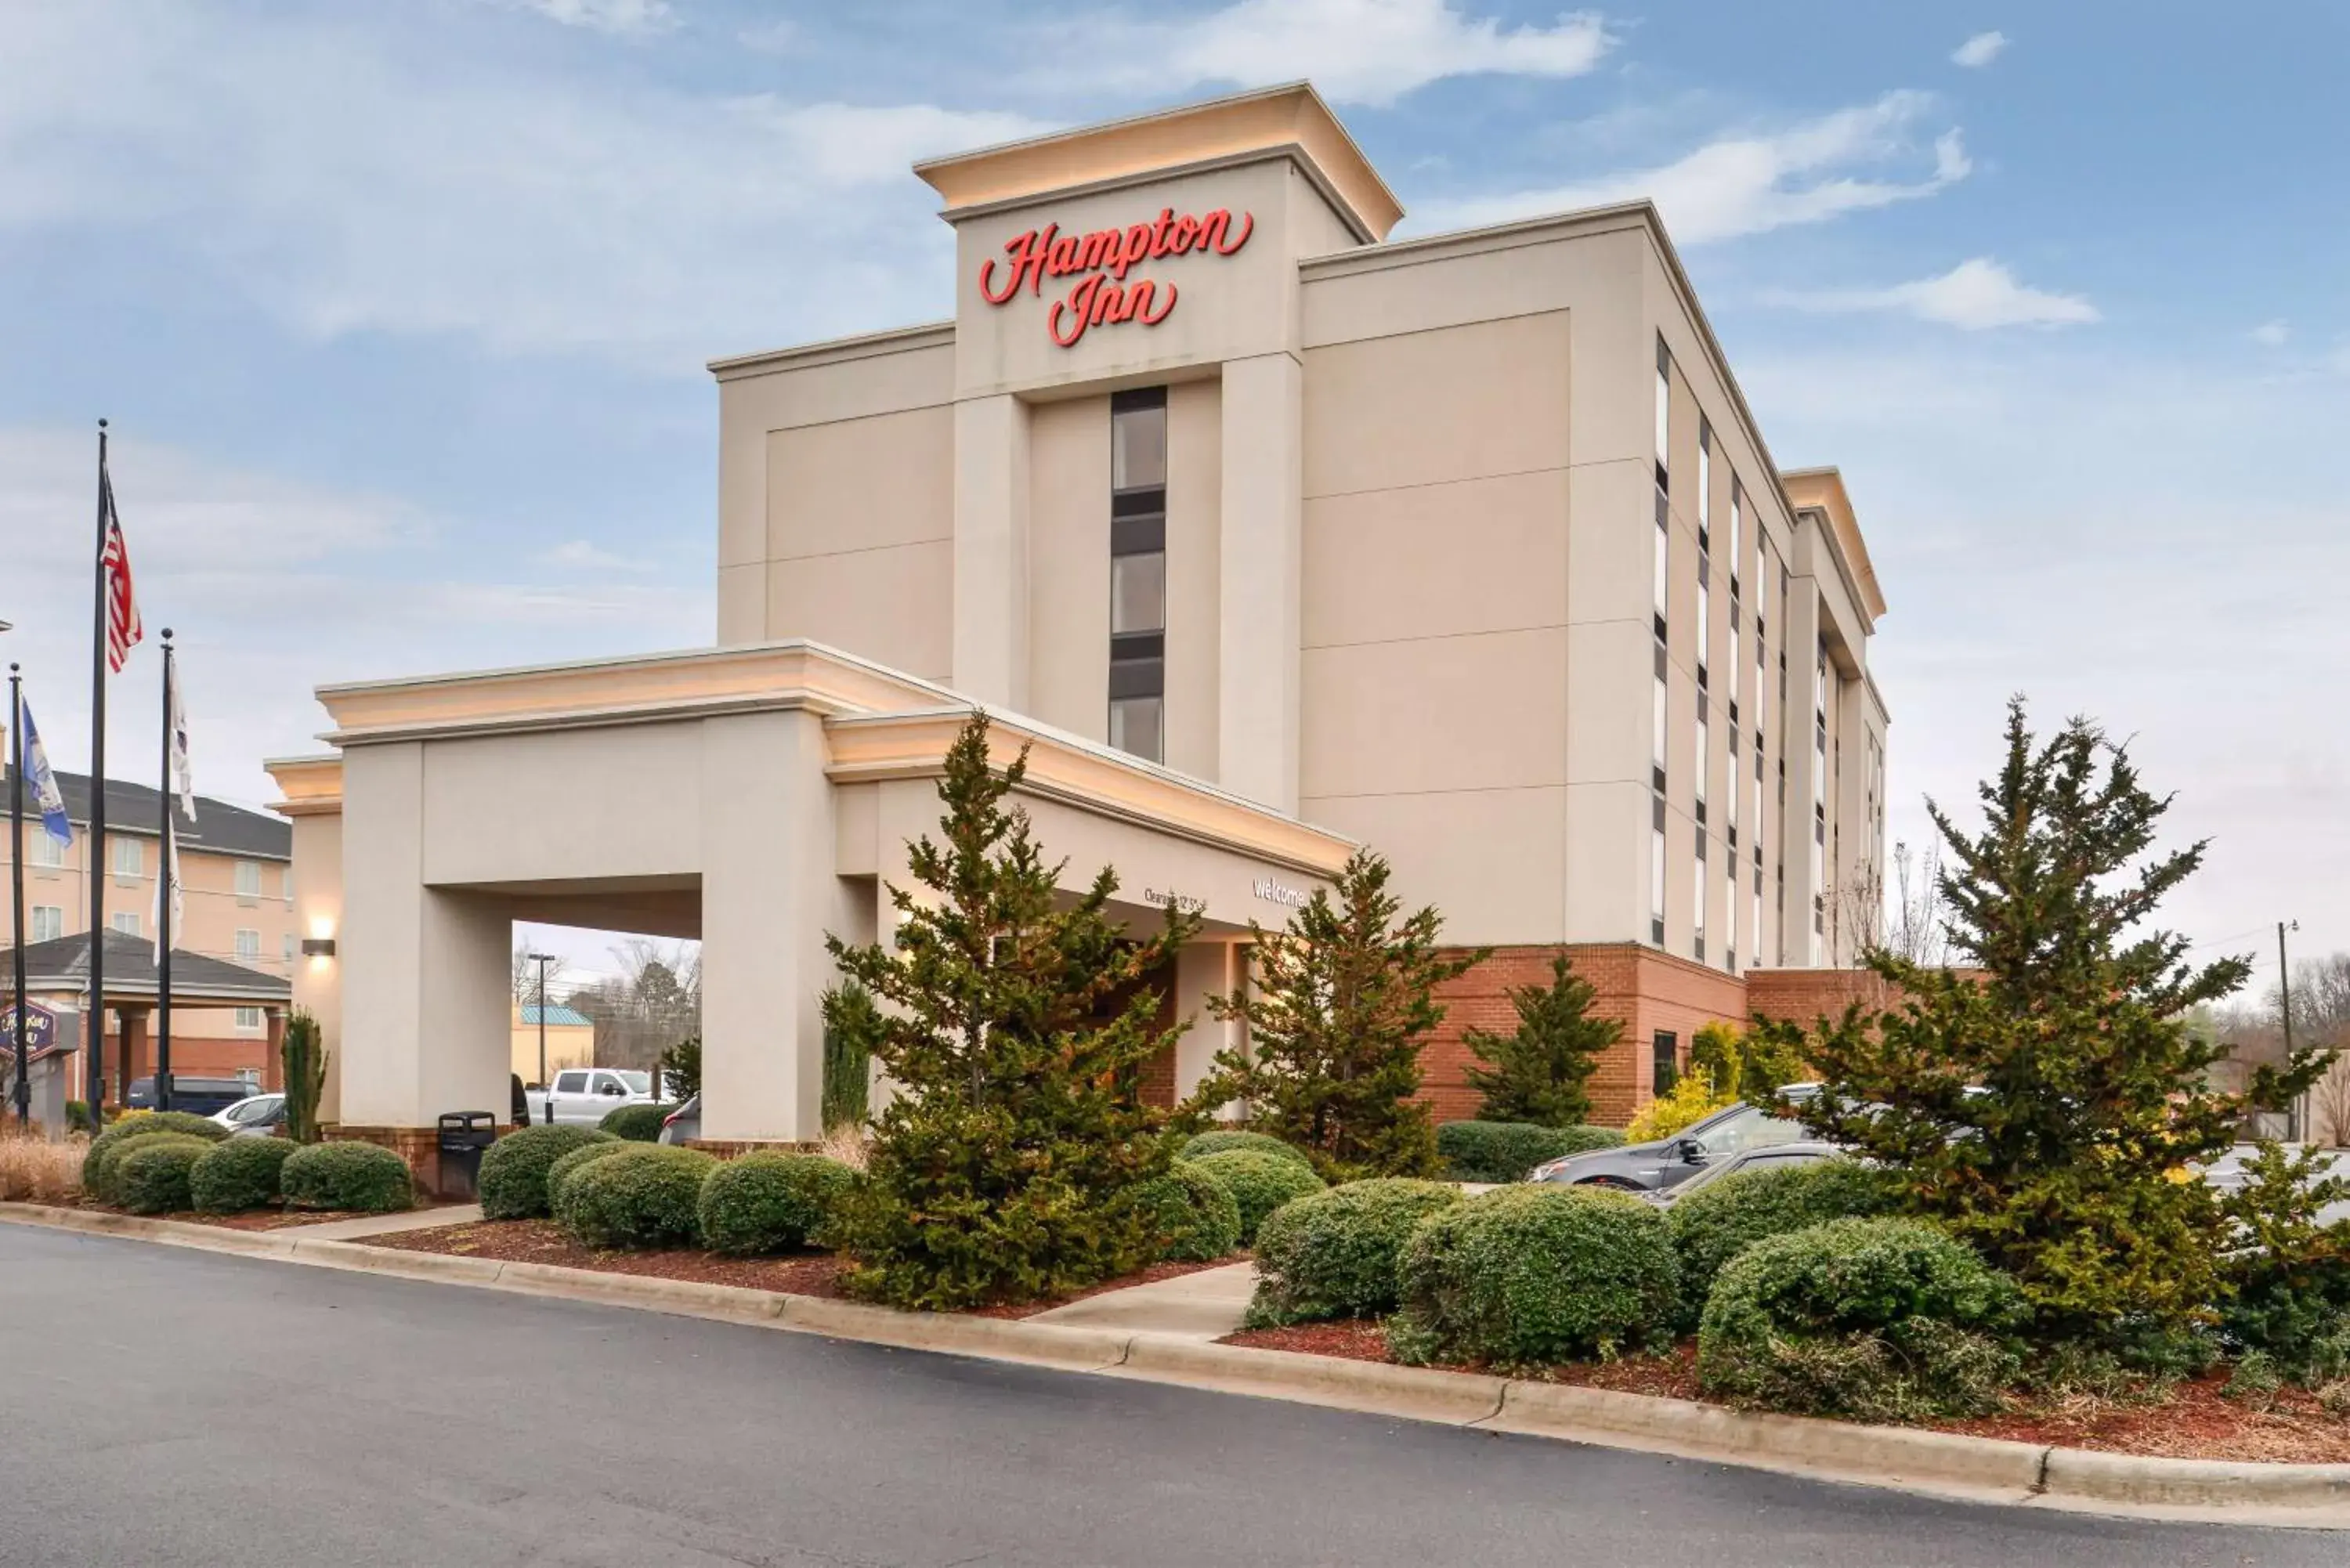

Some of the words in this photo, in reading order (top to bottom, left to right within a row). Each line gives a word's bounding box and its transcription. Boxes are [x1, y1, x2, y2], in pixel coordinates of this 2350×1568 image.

[980, 207, 1254, 305] Hampton
[1048, 273, 1178, 348] Inn
[1144, 888, 1177, 906] Cleara
